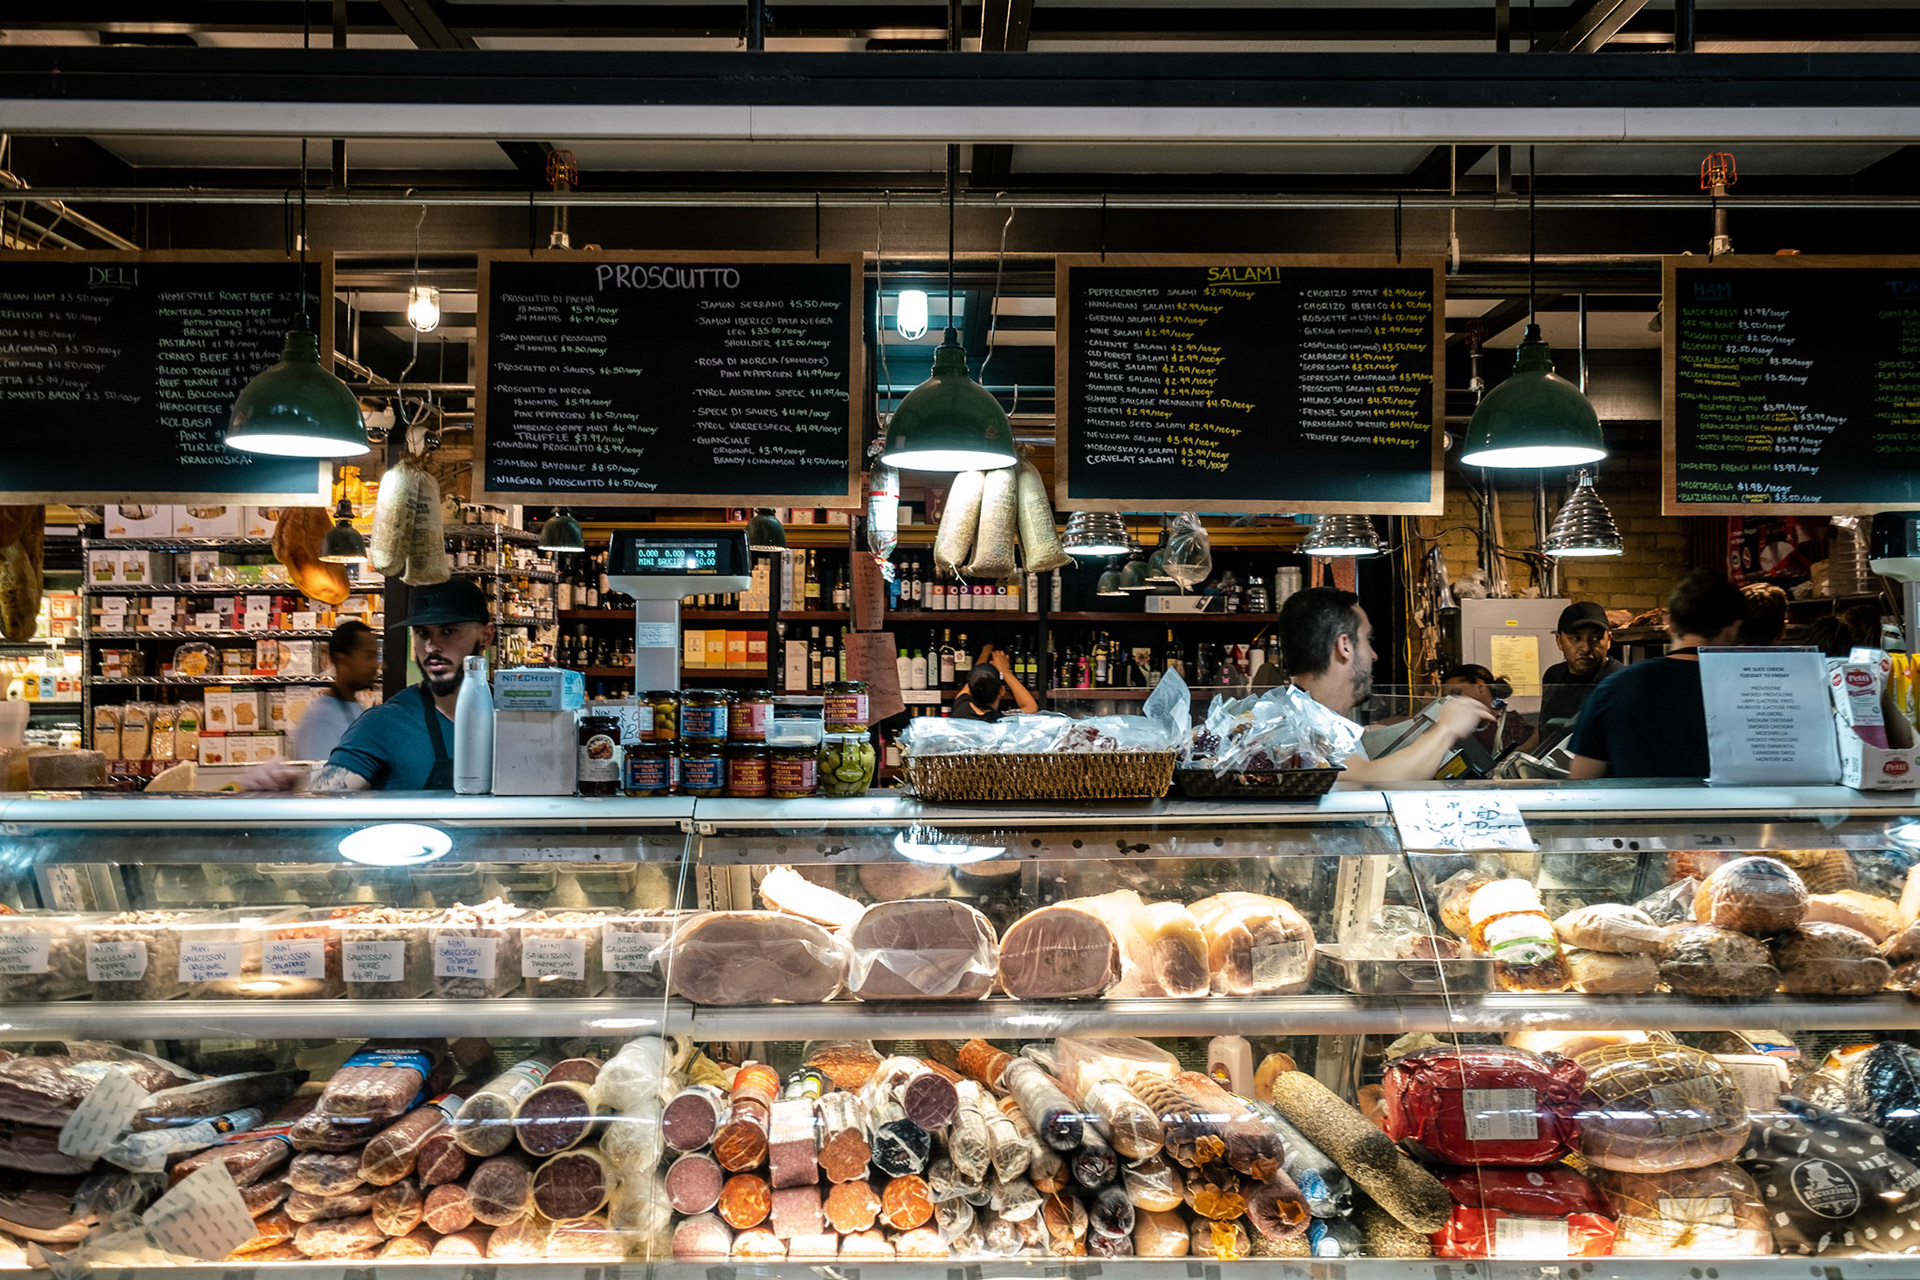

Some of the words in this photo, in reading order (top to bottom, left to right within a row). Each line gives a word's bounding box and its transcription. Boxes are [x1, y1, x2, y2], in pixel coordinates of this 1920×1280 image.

[88, 267, 139, 287] DELI
[595, 264, 741, 291] PROSCIUTTO
[1207, 267, 1280, 281] SALAMI
[1088, 288, 1159, 297] PEPPERCRUSTED
[1167, 289, 1197, 297] SALAMI
[1307, 289, 1347, 298] CHORIZO
[1693, 281, 1731, 298] HAM
[161, 291, 214, 301] HOMESTYLE
[219, 291, 246, 301] ROAST
[250, 292, 274, 301] BEEF
[701, 301, 735, 309] JAMON
[740, 301, 784, 309] SERRANO
[1088, 301, 1138, 310] HUNGARIAN
[1142, 303, 1175, 311] SALAMI
[1303, 302, 1346, 310] CHORIZO
[1351, 302, 1388, 310] IBERICO
[158, 308, 206, 317] MONTREAL
[207, 309, 243, 317] SMOKED
[245, 308, 272, 317] MEAT
[699, 317, 731, 326] JAMON
[735, 316, 773, 325] IBERICO
[800, 317, 833, 325] NEGRA
[1088, 314, 1124, 323] GERMAN
[1127, 315, 1157, 323] SALAMI
[727, 328, 746, 336] LEG
[1112, 329, 1142, 337] SALAMI
[1304, 327, 1336, 335] GENOA
[724, 339, 772, 348] SHOULDER
[1088, 340, 1129, 349] CALIENTE
[1303, 342, 1348, 350] CASALINGO
[159, 352, 194, 361] CORNED
[201, 353, 229, 361] BEEF
[1104, 350, 1132, 360] FOREST
[1136, 354, 1169, 362] SALAMI
[699, 357, 724, 366] ROSA
[740, 357, 779, 365] NORCIA
[1089, 361, 1120, 370] KAISER
[1124, 363, 1157, 371] SALAMI
[1303, 363, 1350, 371] SOPRESSATA
[158, 367, 188, 375] BLOOD
[192, 367, 231, 377] TONGUE
[159, 379, 181, 387] BEEF
[1104, 373, 1124, 381] BEEF
[1128, 375, 1161, 384] SALAMI
[559, 387, 591, 395] NORCIA
[695, 388, 726, 397] TYROL
[729, 389, 771, 397] AUSTRIAN
[775, 389, 806, 398] SPECK
[1088, 384, 1125, 393] SUMMER
[1126, 387, 1158, 395] SALAMI
[158, 390, 184, 399] VEAL
[187, 390, 235, 399] BOLOGNA
[1087, 395, 1117, 404] SUMMER
[1302, 397, 1331, 405] MILANO
[1333, 397, 1364, 405] SALAMI
[159, 403, 222, 413] HEADCHEESE
[698, 407, 728, 416] SPECK
[745, 408, 778, 416] SAURIS
[1339, 409, 1372, 417] SALAMI
[160, 417, 212, 428] KOLBASA
[696, 422, 725, 430] TYROL
[1087, 419, 1127, 428] MUSTARD
[1154, 422, 1186, 430] SALAMI
[1302, 421, 1353, 429] PARMIGIANO
[1356, 421, 1388, 429] TARTUFO
[179, 430, 206, 442] PORK
[514, 432, 569, 441] TRUFFLE
[697, 436, 750, 444] GUANCIALE
[1087, 431, 1130, 440] NEVSKAYA
[1133, 435, 1162, 443] SALAMI
[1304, 433, 1338, 442] TRUFFLE
[1341, 435, 1371, 444] SALAMI
[180, 443, 227, 453] TURKEY
[496, 441, 538, 450] CANADIAN
[542, 443, 595, 452] PROSCIUTTO
[713, 447, 755, 455] ORIGINAL
[1087, 443, 1145, 454] MOSCOVSKAYA
[1147, 447, 1178, 455] SALAMI
[180, 456, 249, 466] KRAKOWSKA
[1087, 455, 1135, 465] CERVELAT
[1138, 456, 1175, 465] SALAMI
[496, 459, 538, 469] JAMBON
[541, 461, 587, 471] BAYONNE
[496, 476, 543, 486] NIAGARA
[548, 477, 605, 488] PROSCIUTTO
[1680, 481, 1734, 491] MORTADELLA
[1680, 494, 1739, 502] BUZHENINA
[638, 549, 659, 558] 0.000
[664, 549, 685, 558] 0.000
[695, 549, 716, 558] 79.99
[638, 558, 655, 566] MINI
[502, 674, 538, 682] NITECH
[448, 940, 466, 948] MINI
[617, 936, 637, 944] MINI
[272, 944, 291, 952] MINI
[356, 944, 377, 953] MINI
[439, 948, 481, 957] SAUCISSON
[606, 945, 651, 953] SAUCISSON
[90, 952, 137, 963] SAUCISSON
[181, 952, 226, 963] SAUCISSON
[265, 951, 311, 963] SAUCISSON
[346, 953, 391, 961] SAUCISSON
[525, 952, 571, 960] SAUCISSON
